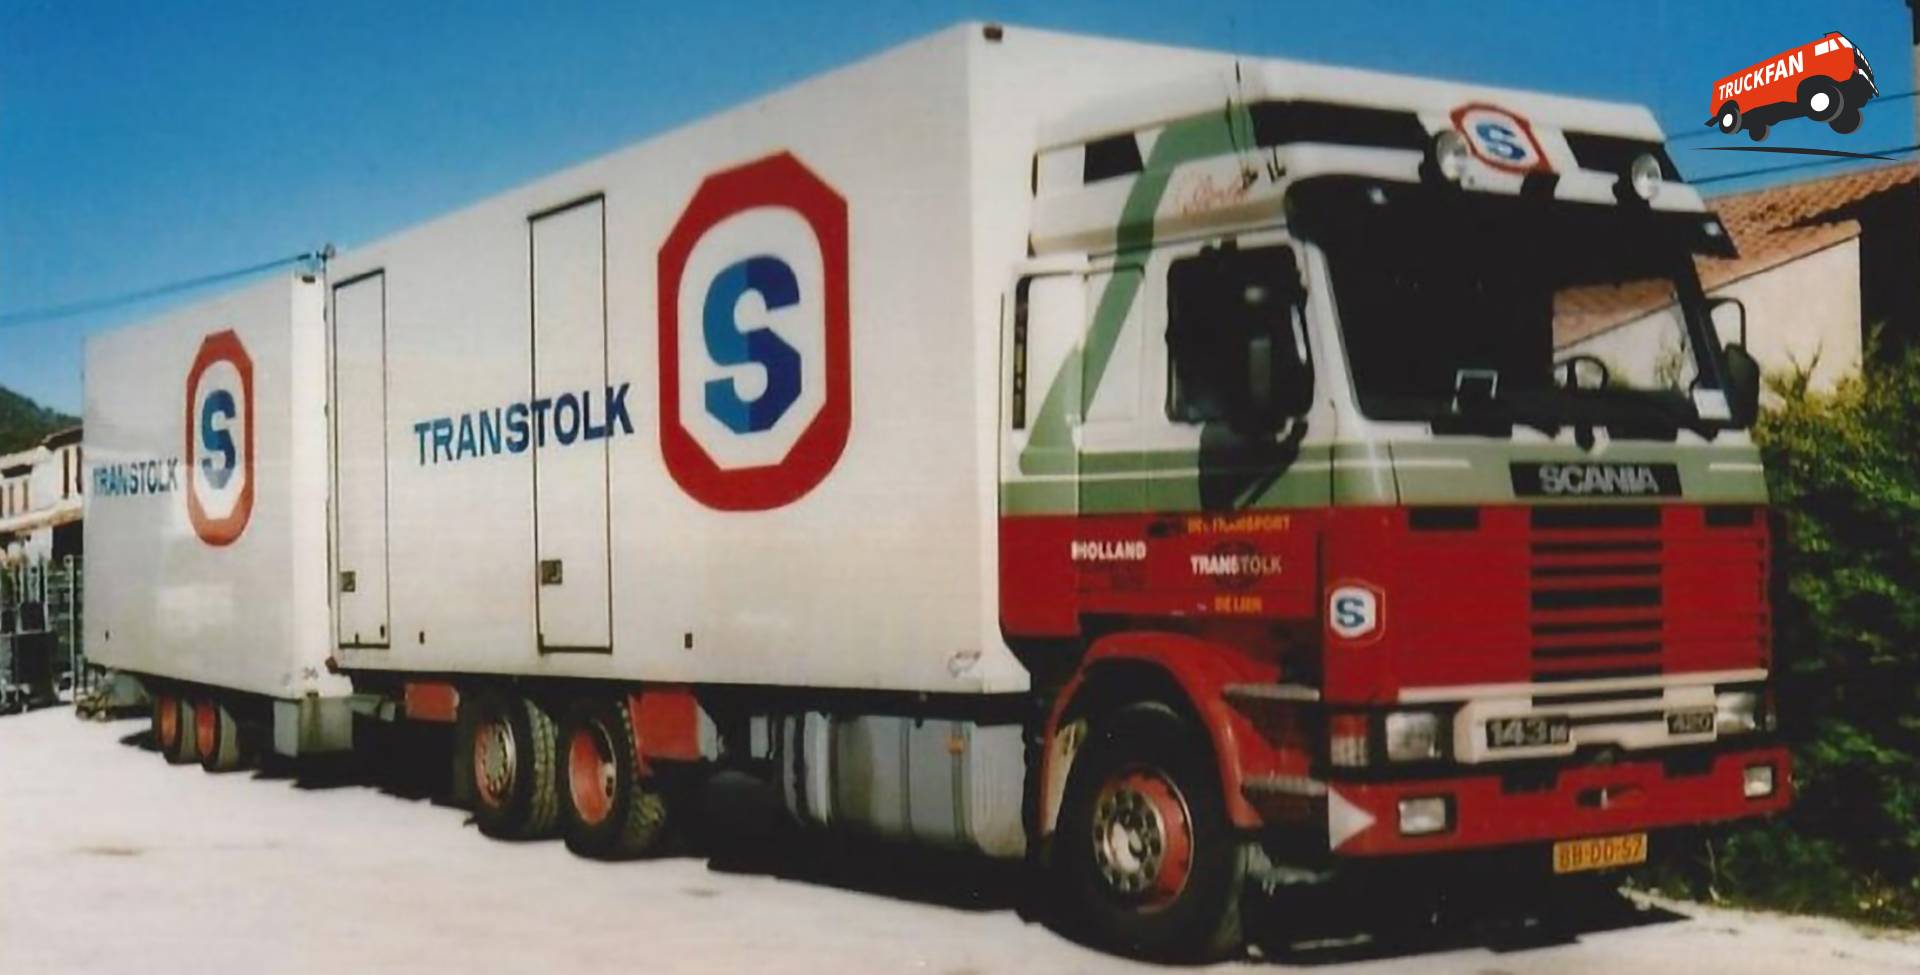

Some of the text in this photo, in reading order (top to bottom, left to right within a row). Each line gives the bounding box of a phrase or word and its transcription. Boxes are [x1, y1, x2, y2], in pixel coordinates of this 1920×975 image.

[1475, 123, 1527, 161] S
[702, 255, 802, 434] S
[201, 389, 236, 489] S
[415, 383, 634, 466] TRANSTOLK
[93, 456, 178, 496] TRANSTOLK
[1538, 465, 1660, 493] SCANIA
[1190, 554, 1282, 575] TRANSTOLK
[1336, 597, 1365, 628] S
